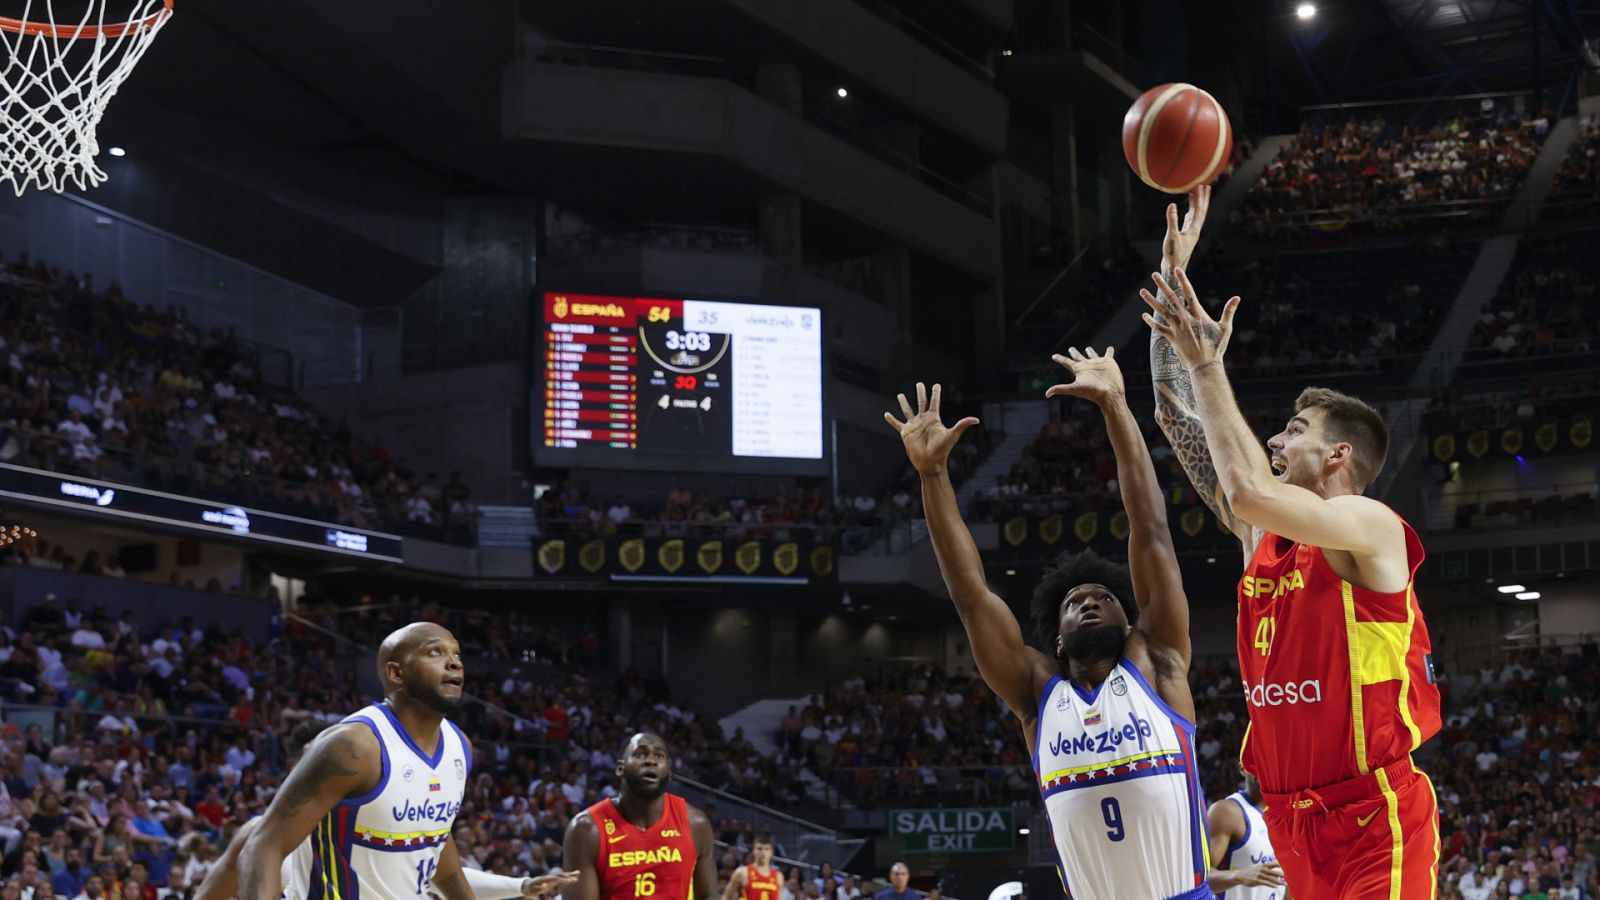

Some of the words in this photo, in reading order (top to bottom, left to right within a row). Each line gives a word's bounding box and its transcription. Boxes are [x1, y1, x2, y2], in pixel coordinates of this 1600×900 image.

[571, 303, 625, 318] ESPAÑA
[648, 306, 671, 323] 54
[698, 310, 718, 325] 35
[665, 330, 711, 352] 3:03
[658, 394, 670, 409] 4
[699, 396, 712, 411] 4
[896, 811, 1006, 834] SALIDA
[1100, 796, 1125, 842] 9
[927, 833, 976, 850] EXIT
[608, 846, 683, 868] ESPAÑA
[634, 872, 657, 897] 16
